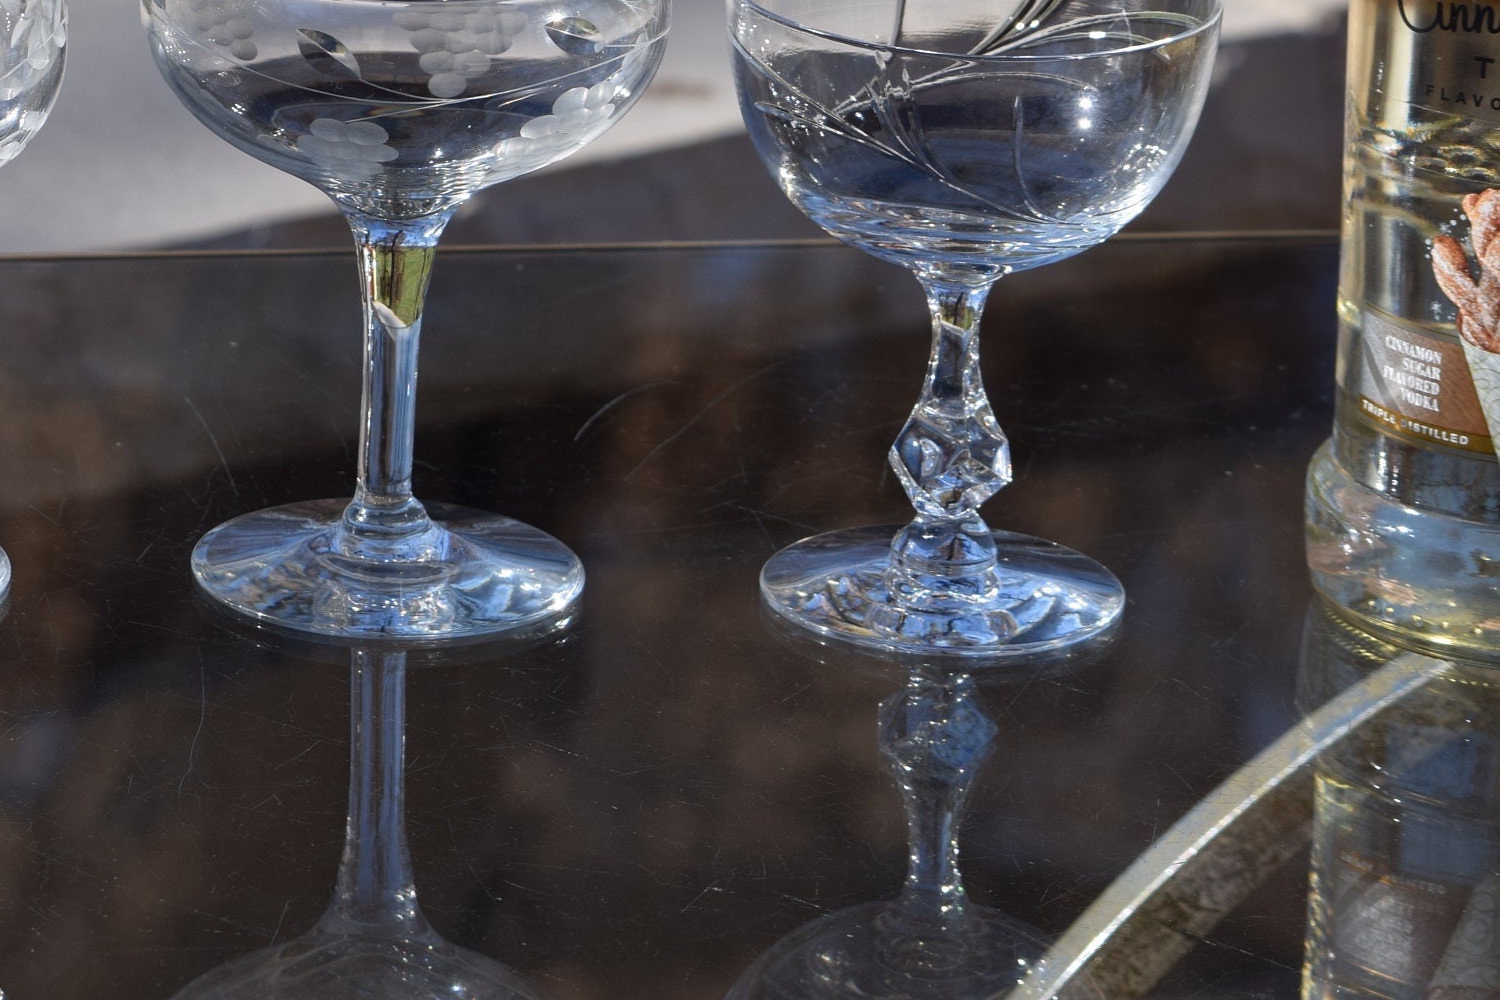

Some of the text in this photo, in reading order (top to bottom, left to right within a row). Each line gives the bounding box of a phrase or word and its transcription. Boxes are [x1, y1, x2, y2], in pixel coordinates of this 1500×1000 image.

[1473, 56, 1495, 79] T
[1426, 84, 1500, 110] FLAVO
[1385, 335, 1442, 365] CINNAMON
[1383, 365, 1440, 395] FLAVORED
[1402, 357, 1441, 381] SUGAR
[1400, 387, 1440, 412] VODKA
[1362, 399, 1469, 445] TRIPLE DISTILLED
